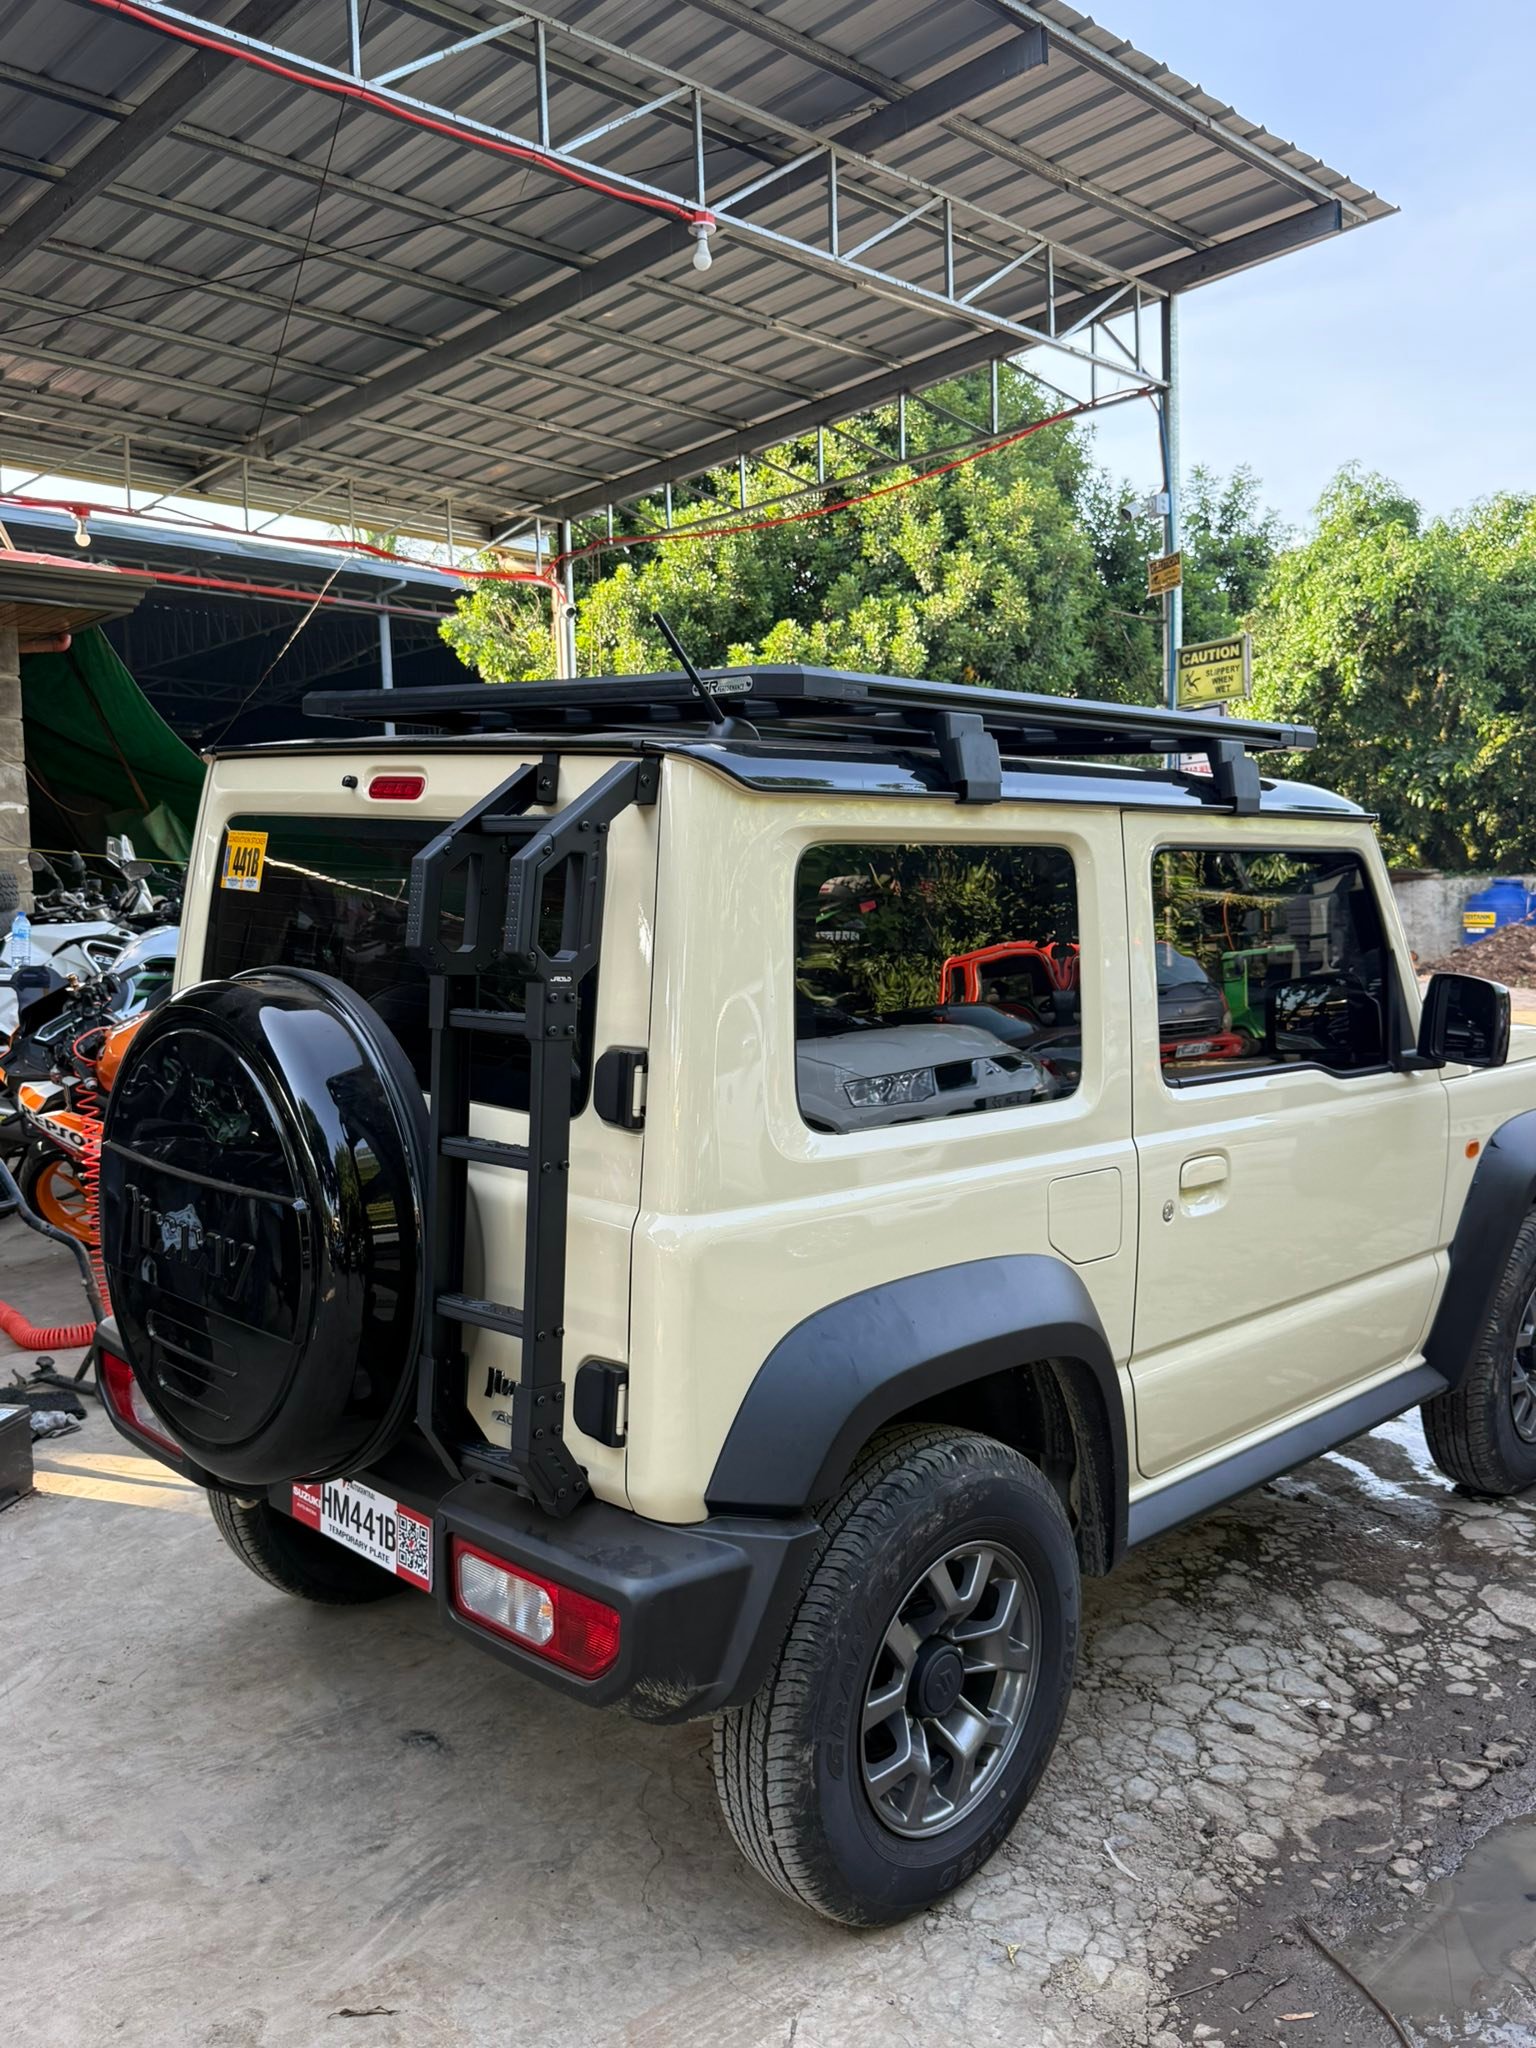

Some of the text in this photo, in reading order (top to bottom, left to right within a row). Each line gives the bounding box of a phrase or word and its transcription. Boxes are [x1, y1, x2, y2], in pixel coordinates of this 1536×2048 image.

[1181, 643, 1240, 666] CAUTION
[1205, 665, 1240, 677] SLIPPERY
[1211, 675, 1234, 685] WHEN
[1215, 684, 1231, 693] WET
[232, 846, 261, 877] 441B
[292, 1485, 321, 1508] SUZUKI
[321, 1486, 396, 1552] HM441B
[328, 1524, 391, 1564] TEMPORARY PLATE
